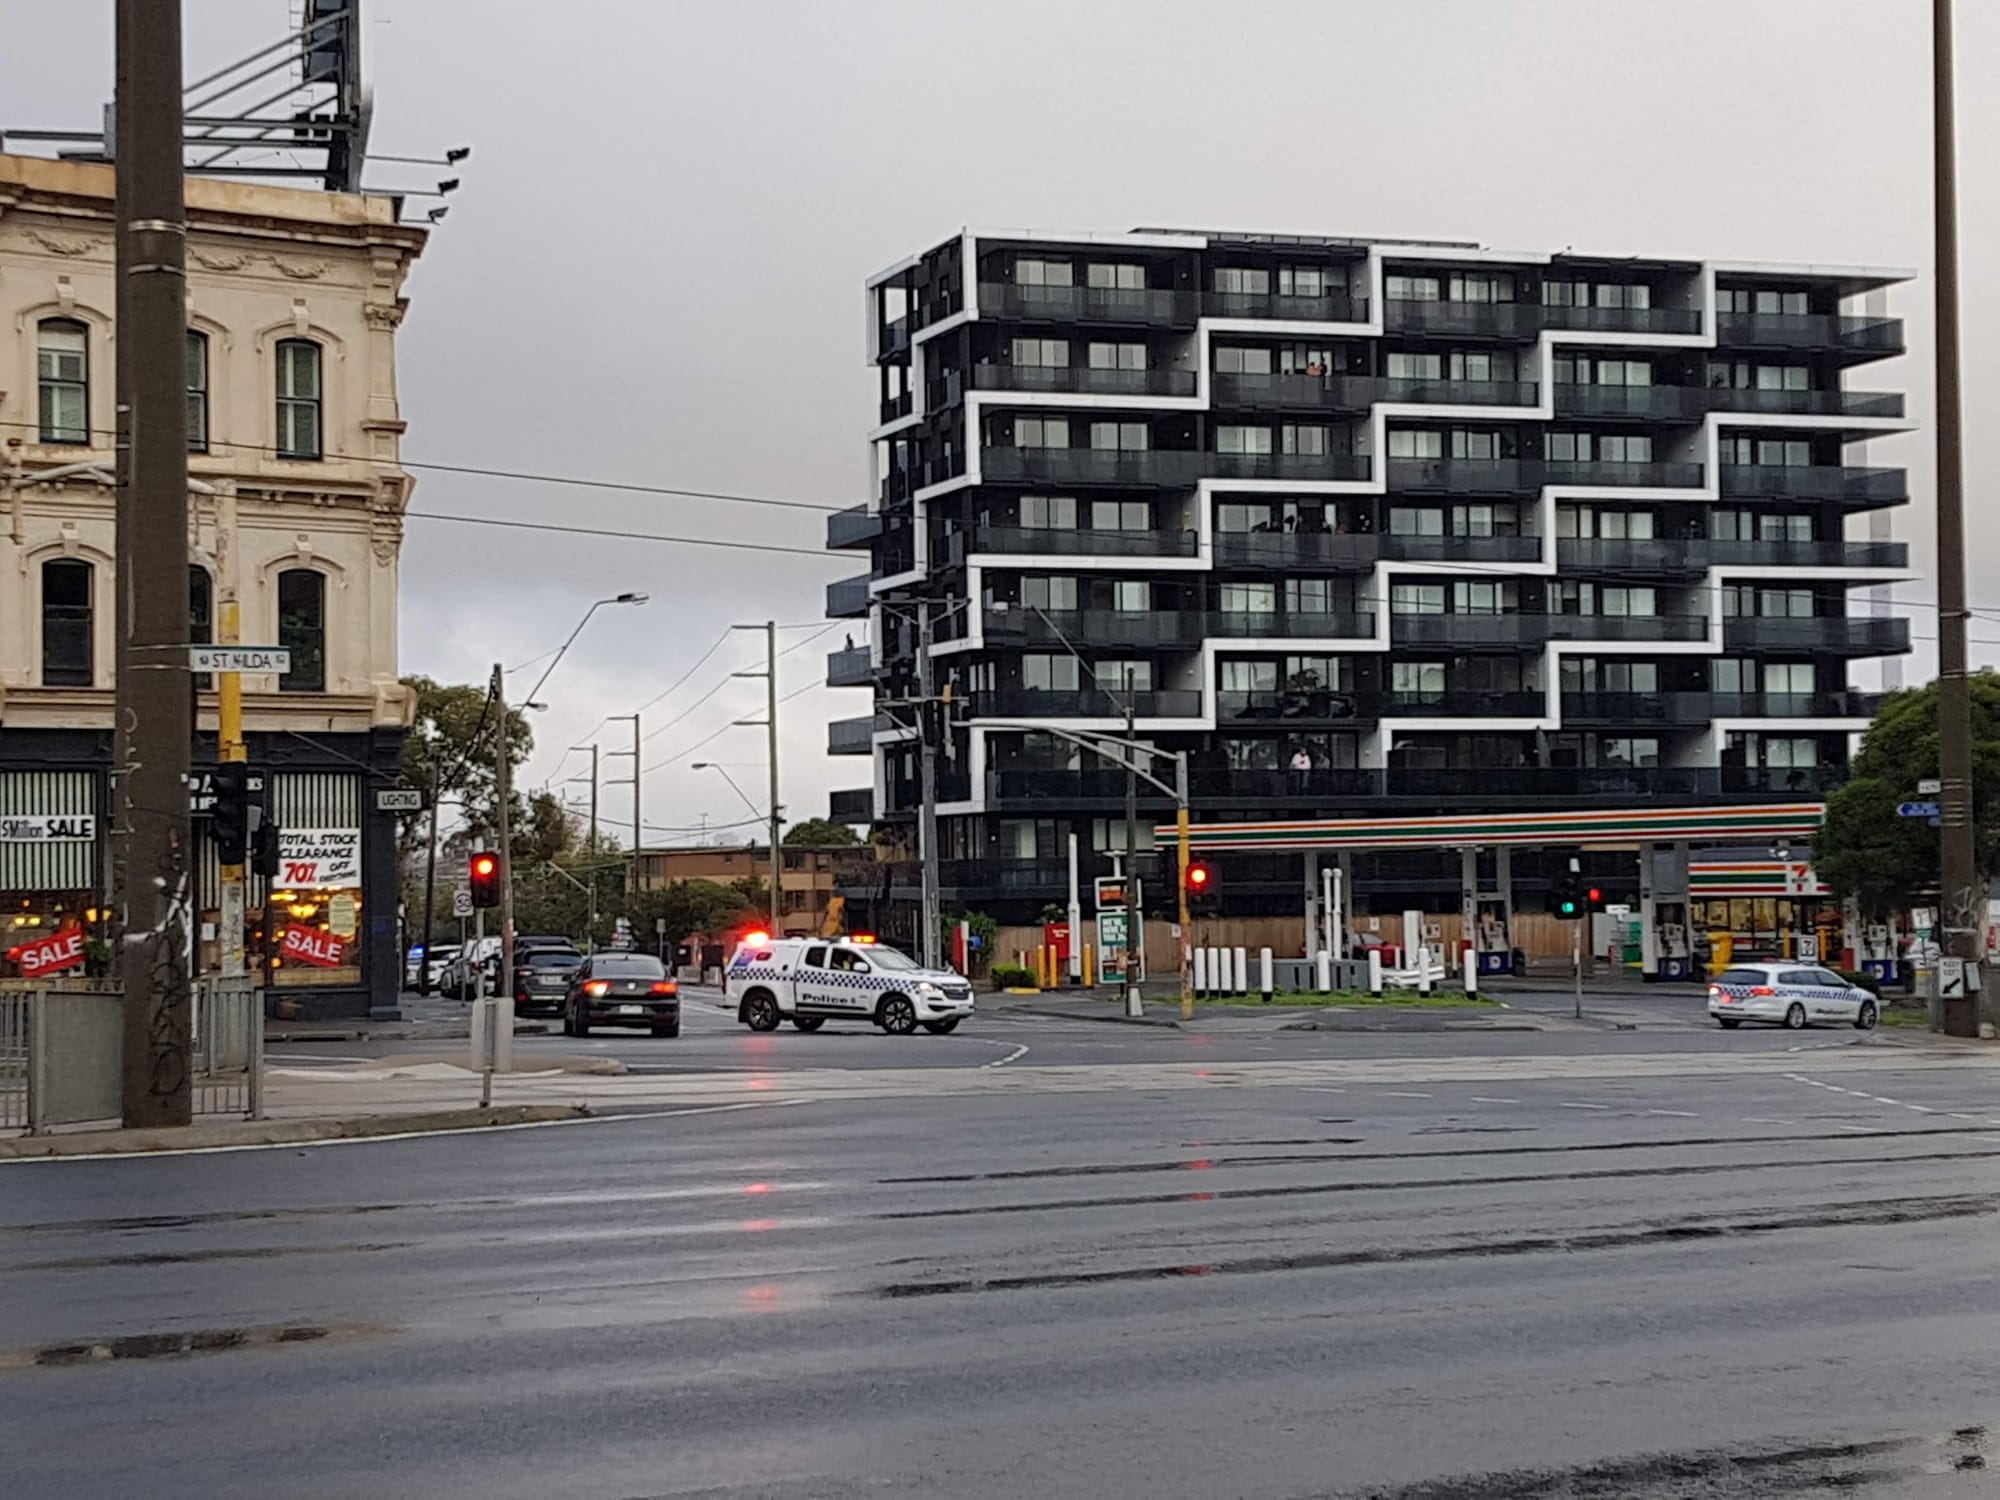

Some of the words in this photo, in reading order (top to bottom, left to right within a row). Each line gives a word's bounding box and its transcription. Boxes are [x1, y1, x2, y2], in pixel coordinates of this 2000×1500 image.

[212, 653, 229, 668] ST
[232, 653, 273, 668] KILDA
[47, 819, 92, 838] SALE
[280, 833, 316, 846] TOTAL
[320, 833, 358, 846] STOCK
[279, 847, 354, 859] CLEARANCE
[328, 861, 351, 872] OFF
[21, 934, 82, 970] SALE
[285, 930, 342, 962] SALE
[803, 992, 849, 1004] Police
